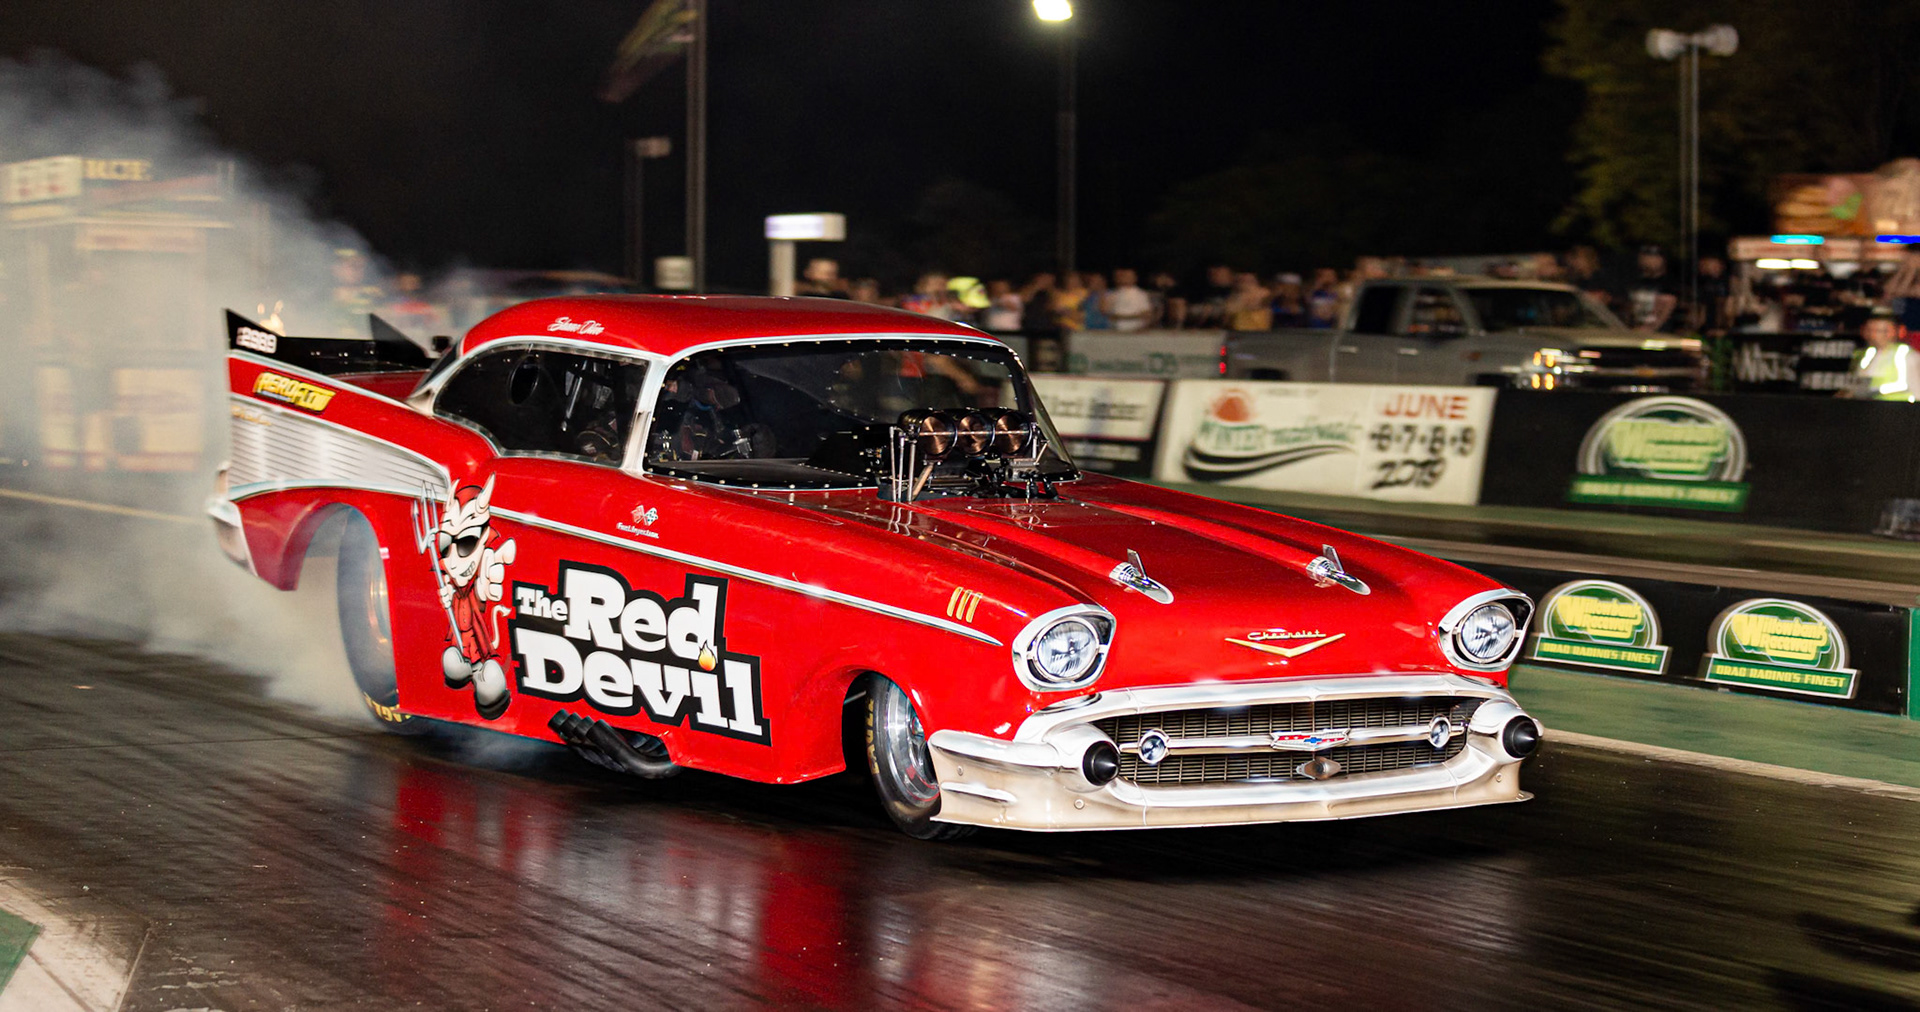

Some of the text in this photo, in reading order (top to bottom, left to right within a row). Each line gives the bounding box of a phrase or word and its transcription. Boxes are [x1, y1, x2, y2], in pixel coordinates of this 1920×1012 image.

[1383, 394, 1470, 420] JUNE
[517, 569, 719, 664] The Red
[1247, 629, 1327, 641] Chevrolet
[1620, 650, 1659, 665] FINEST
[514, 627, 763, 736] Devil
[1803, 673, 1846, 688] FINEST
